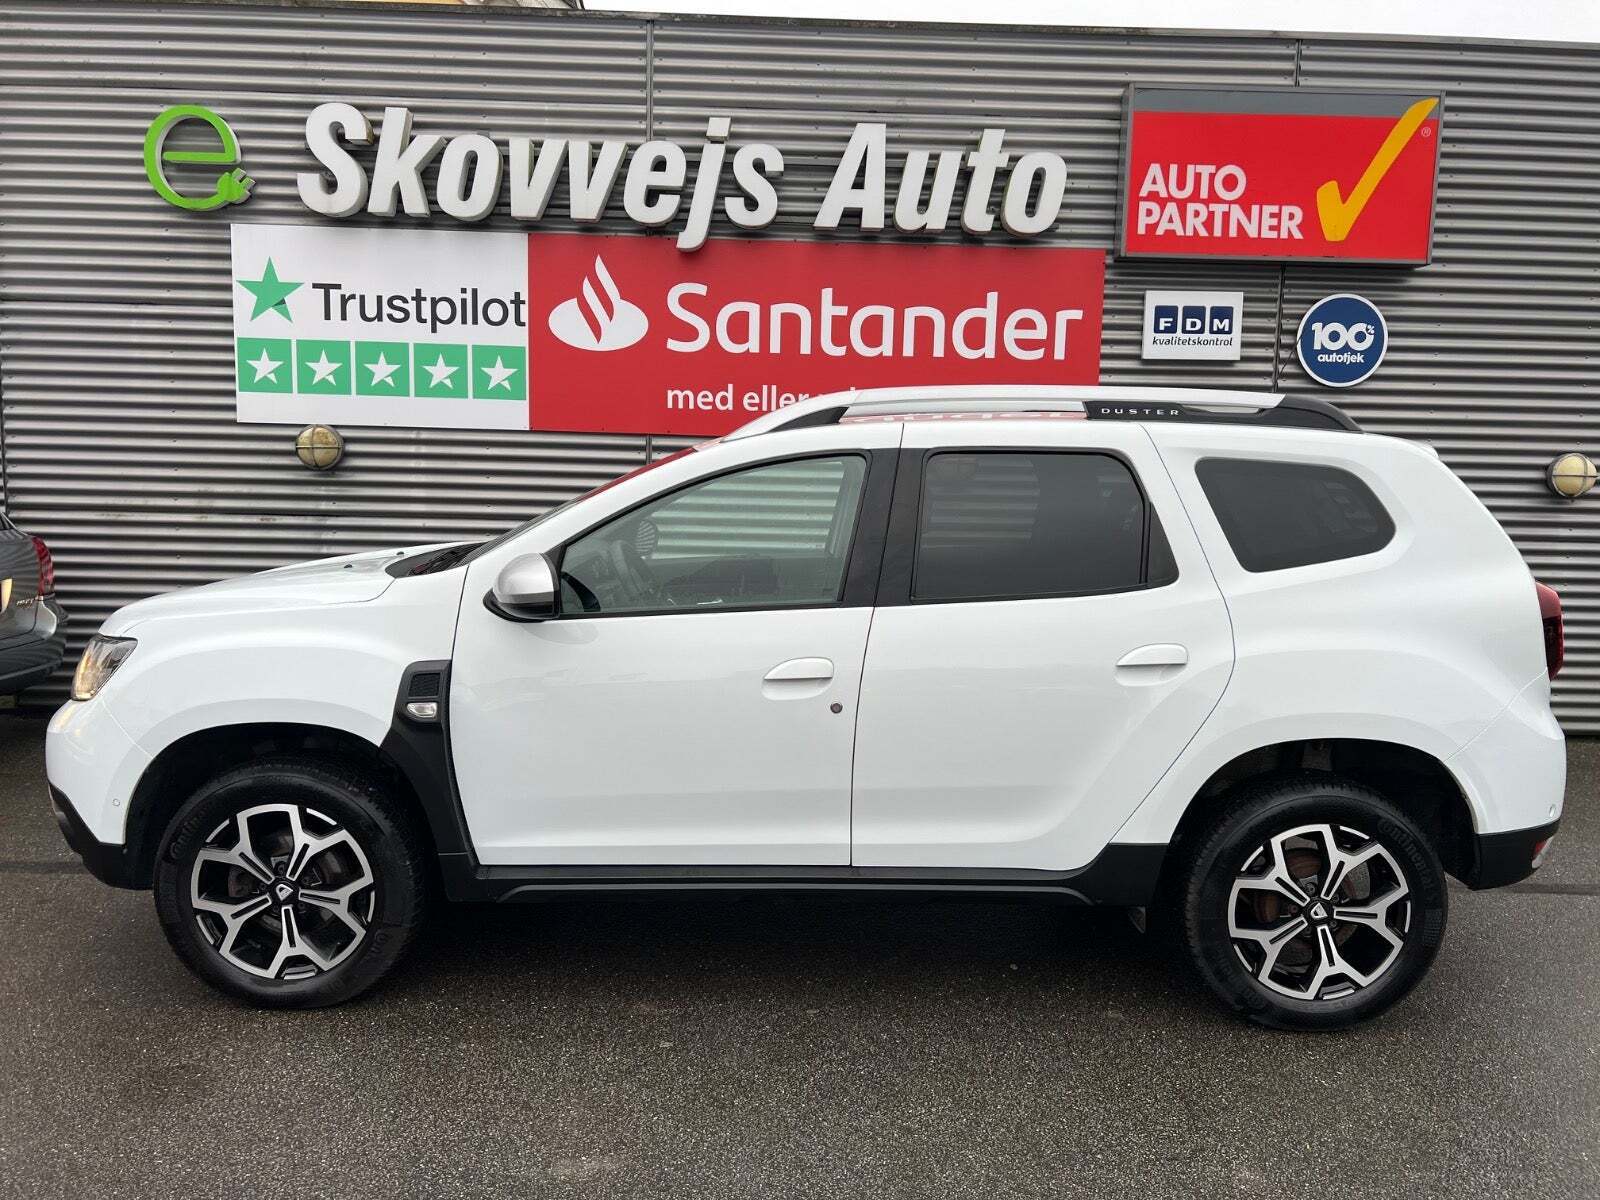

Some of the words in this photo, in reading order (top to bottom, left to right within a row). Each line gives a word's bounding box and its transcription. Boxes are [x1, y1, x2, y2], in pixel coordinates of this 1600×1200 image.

[297, 102, 785, 252] Skovvejs
[813, 122, 1069, 238] Auto
[1138, 162, 1247, 201] AUTO
[1136, 201, 1304, 239] PARTNER
[312, 282, 526, 333] Trustpilot
[666, 282, 1084, 361] Santander
[1152, 335, 1233, 347] kvalitetskontrol
[1317, 351, 1365, 365] autotjek
[666, 383, 734, 411] med
[1101, 407, 1180, 416] DUSTER
